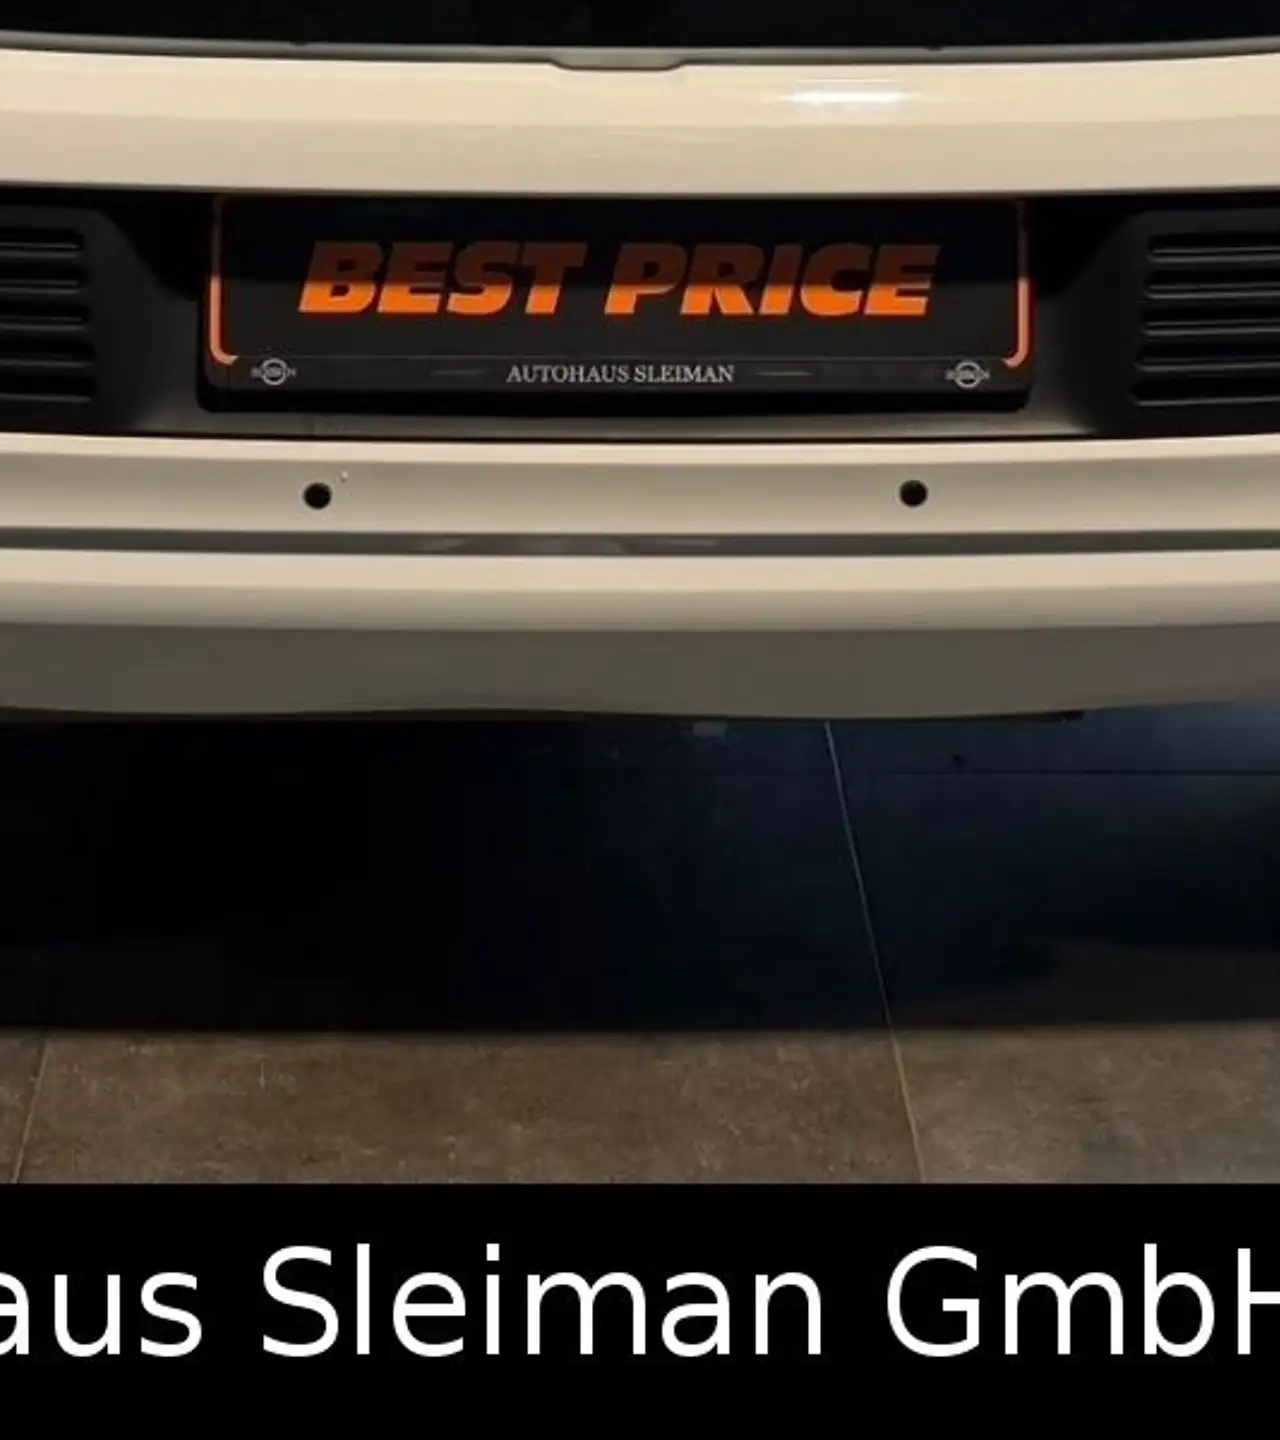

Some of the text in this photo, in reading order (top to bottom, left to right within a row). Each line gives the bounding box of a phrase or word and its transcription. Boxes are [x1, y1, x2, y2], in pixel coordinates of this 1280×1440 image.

[297, 240, 941, 318] BEST PRICE
[505, 364, 735, 384] AUTOHAUS SLEIMAN
